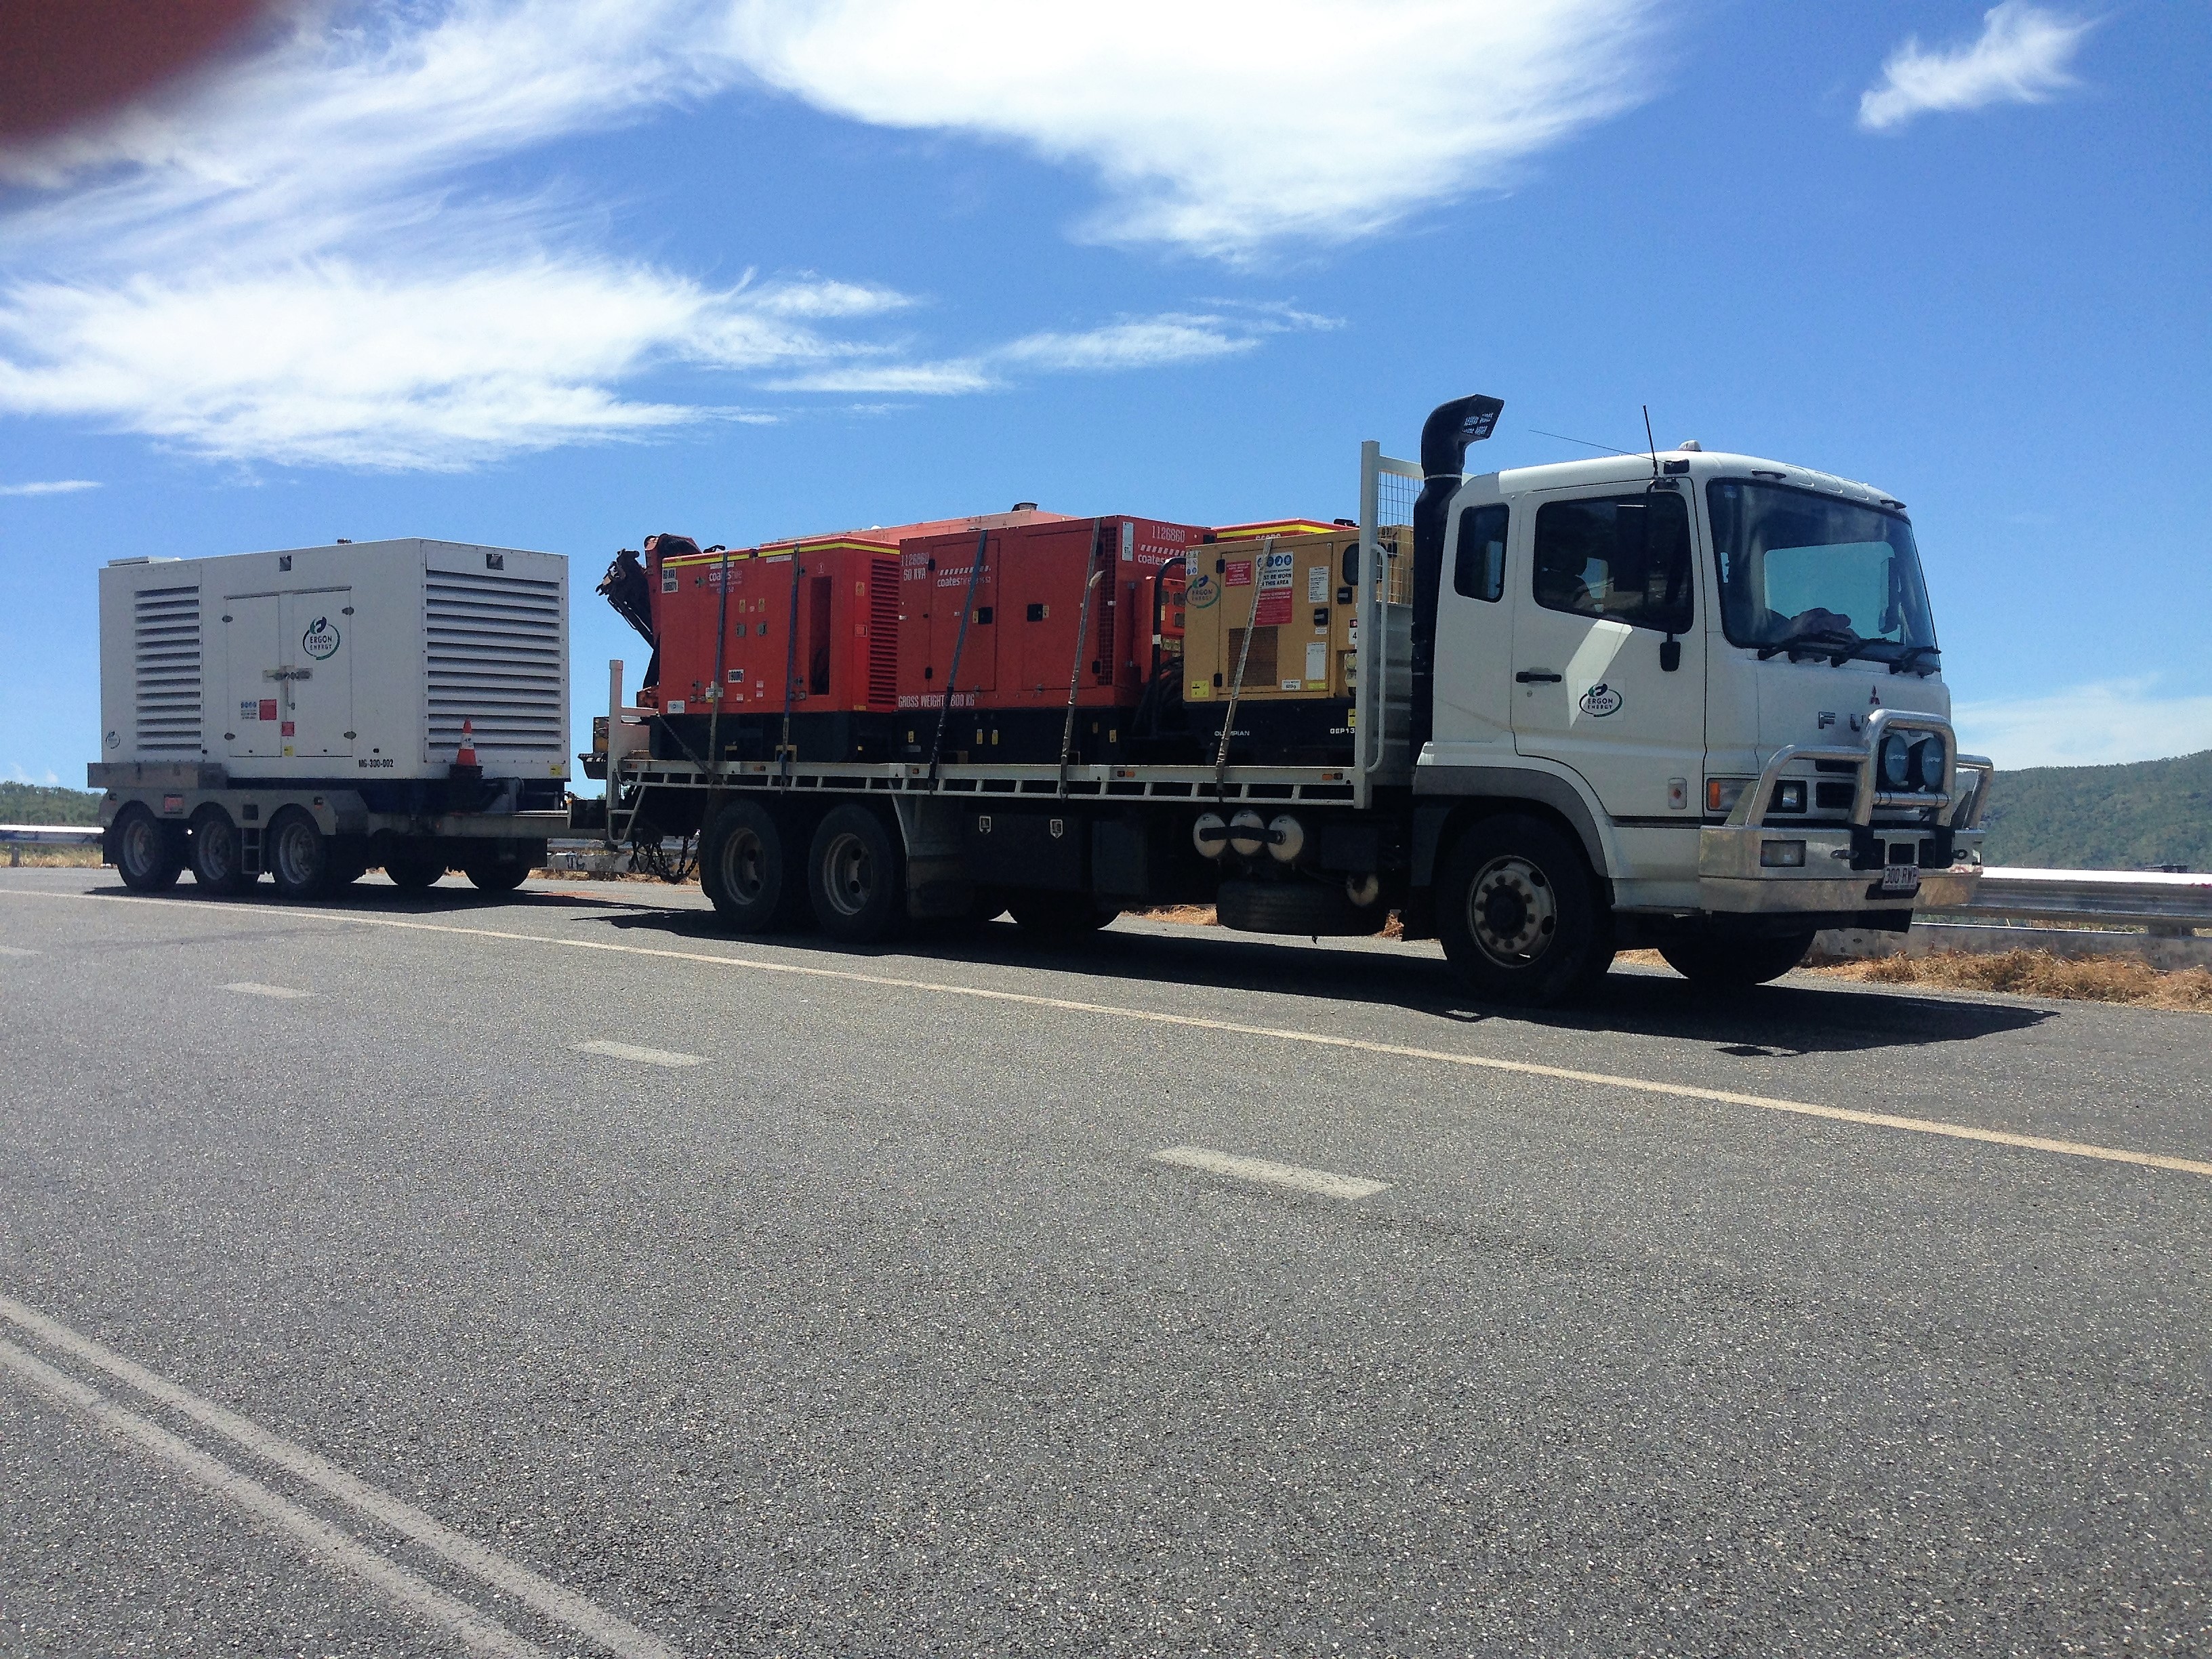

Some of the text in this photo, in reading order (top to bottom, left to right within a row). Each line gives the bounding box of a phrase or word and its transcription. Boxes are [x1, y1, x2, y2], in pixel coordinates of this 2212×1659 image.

[310, 636, 332, 644] ERGON
[898, 695, 919, 708] GROSS
[921, 695, 945, 707] WEIGHT
